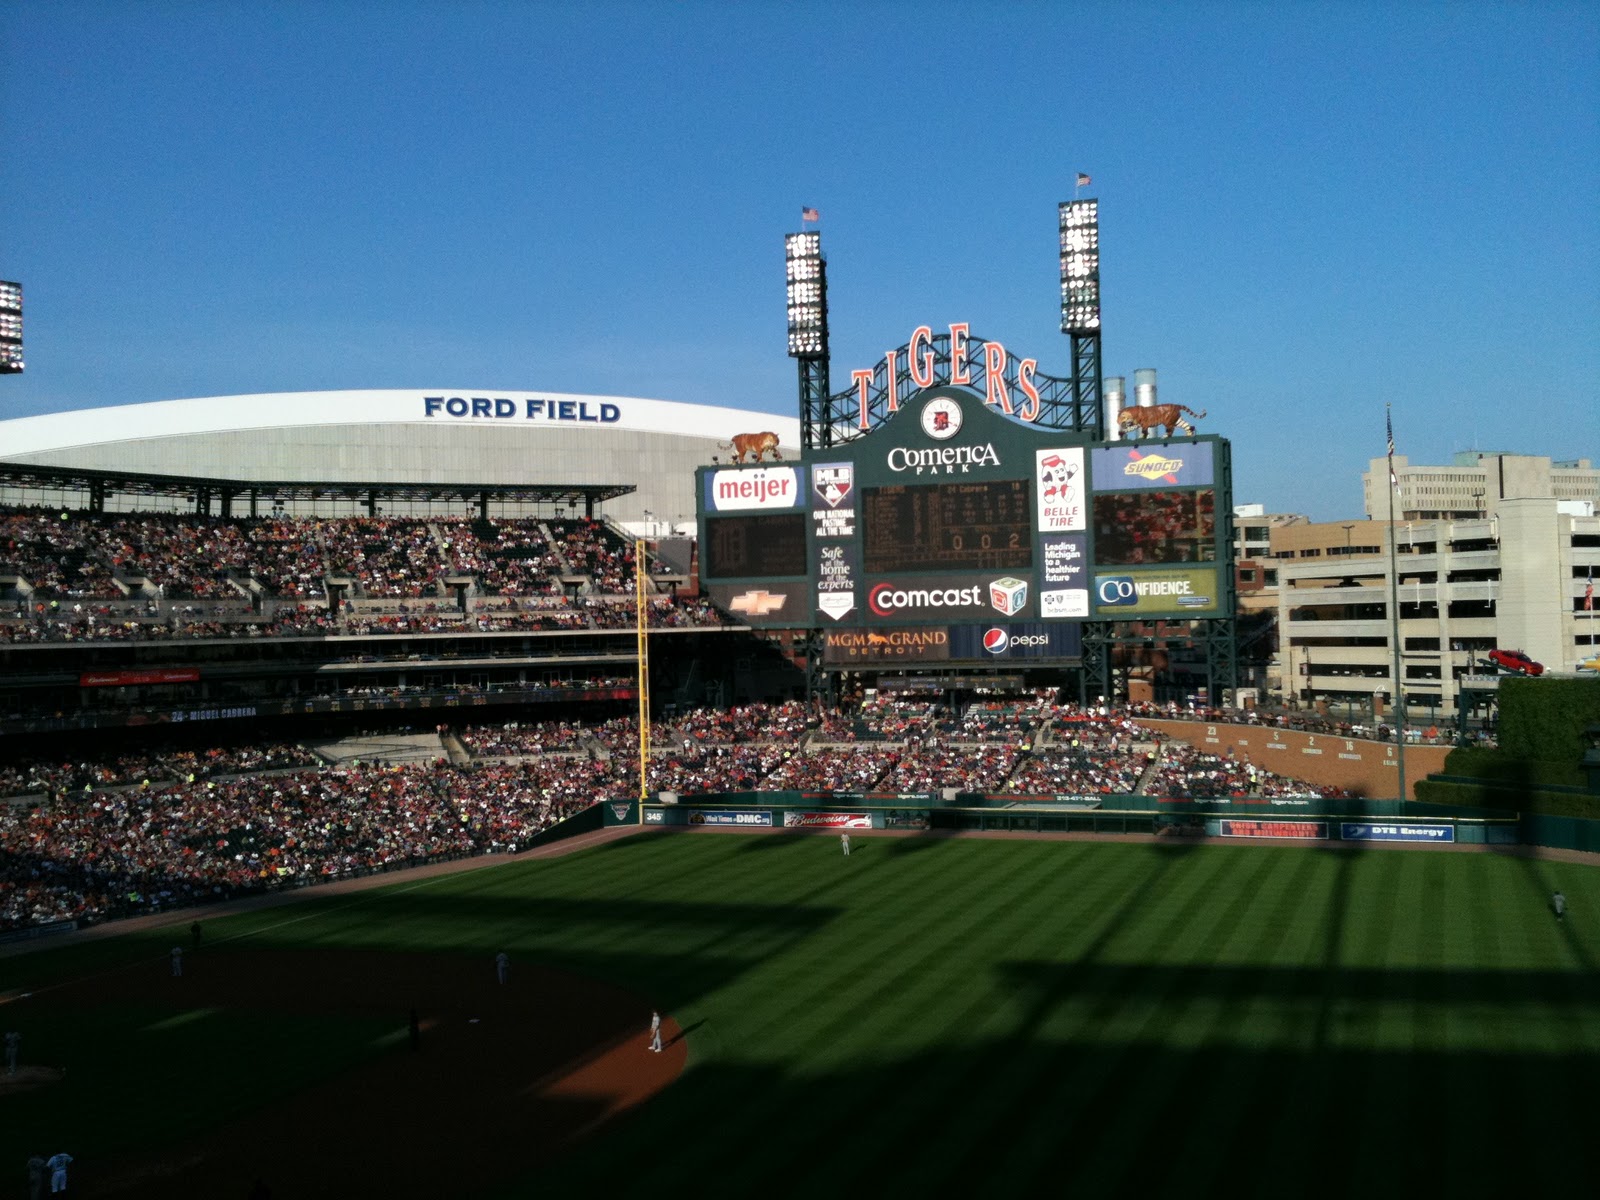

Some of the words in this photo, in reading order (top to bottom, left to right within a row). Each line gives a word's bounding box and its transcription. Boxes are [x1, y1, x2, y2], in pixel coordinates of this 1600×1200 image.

[851, 322, 1040, 430] TIGERS
[423, 396, 517, 418] FORD
[525, 398, 621, 423] FIELD
[916, 463, 969, 476] PARK
[1127, 460, 1181, 474] SUNOCO
[816, 468, 850, 481] MLB
[719, 473, 790, 503] meijer
[813, 510, 826, 520] OUR
[827, 508, 855, 519] NATIONAL
[1044, 506, 1079, 516] BELLE
[822, 518, 847, 527] PASTIME
[1049, 517, 1074, 527] TIRE
[816, 527, 827, 536] ALL
[827, 526, 838, 536] THE
[821, 546, 844, 560] Safe
[1045, 543, 1076, 552] Leading
[1045, 551, 1081, 560] Michigan
[820, 563, 851, 575] home
[1045, 565, 1081, 574] healthier
[835, 573, 847, 581] the
[1045, 573, 1070, 582] future
[817, 579, 854, 592] experts
[877, 585, 982, 609] comcast
[827, 634, 865, 647] MGM
[889, 632, 947, 646] GRAND
[1010, 634, 1049, 648] pepsi
[850, 646, 924, 656] DETROIT
[171, 711, 183, 723] 24
[190, 709, 220, 721] MIGUEL
[221, 707, 257, 719] CABRERA
[1309, 736, 1315, 746] 2
[1345, 741, 1354, 751] 16
[1387, 747, 1393, 757] 6
[793, 814, 850, 827] Budweiser
[1371, 826, 1398, 835] DTE
[1400, 827, 1445, 837] Energy
